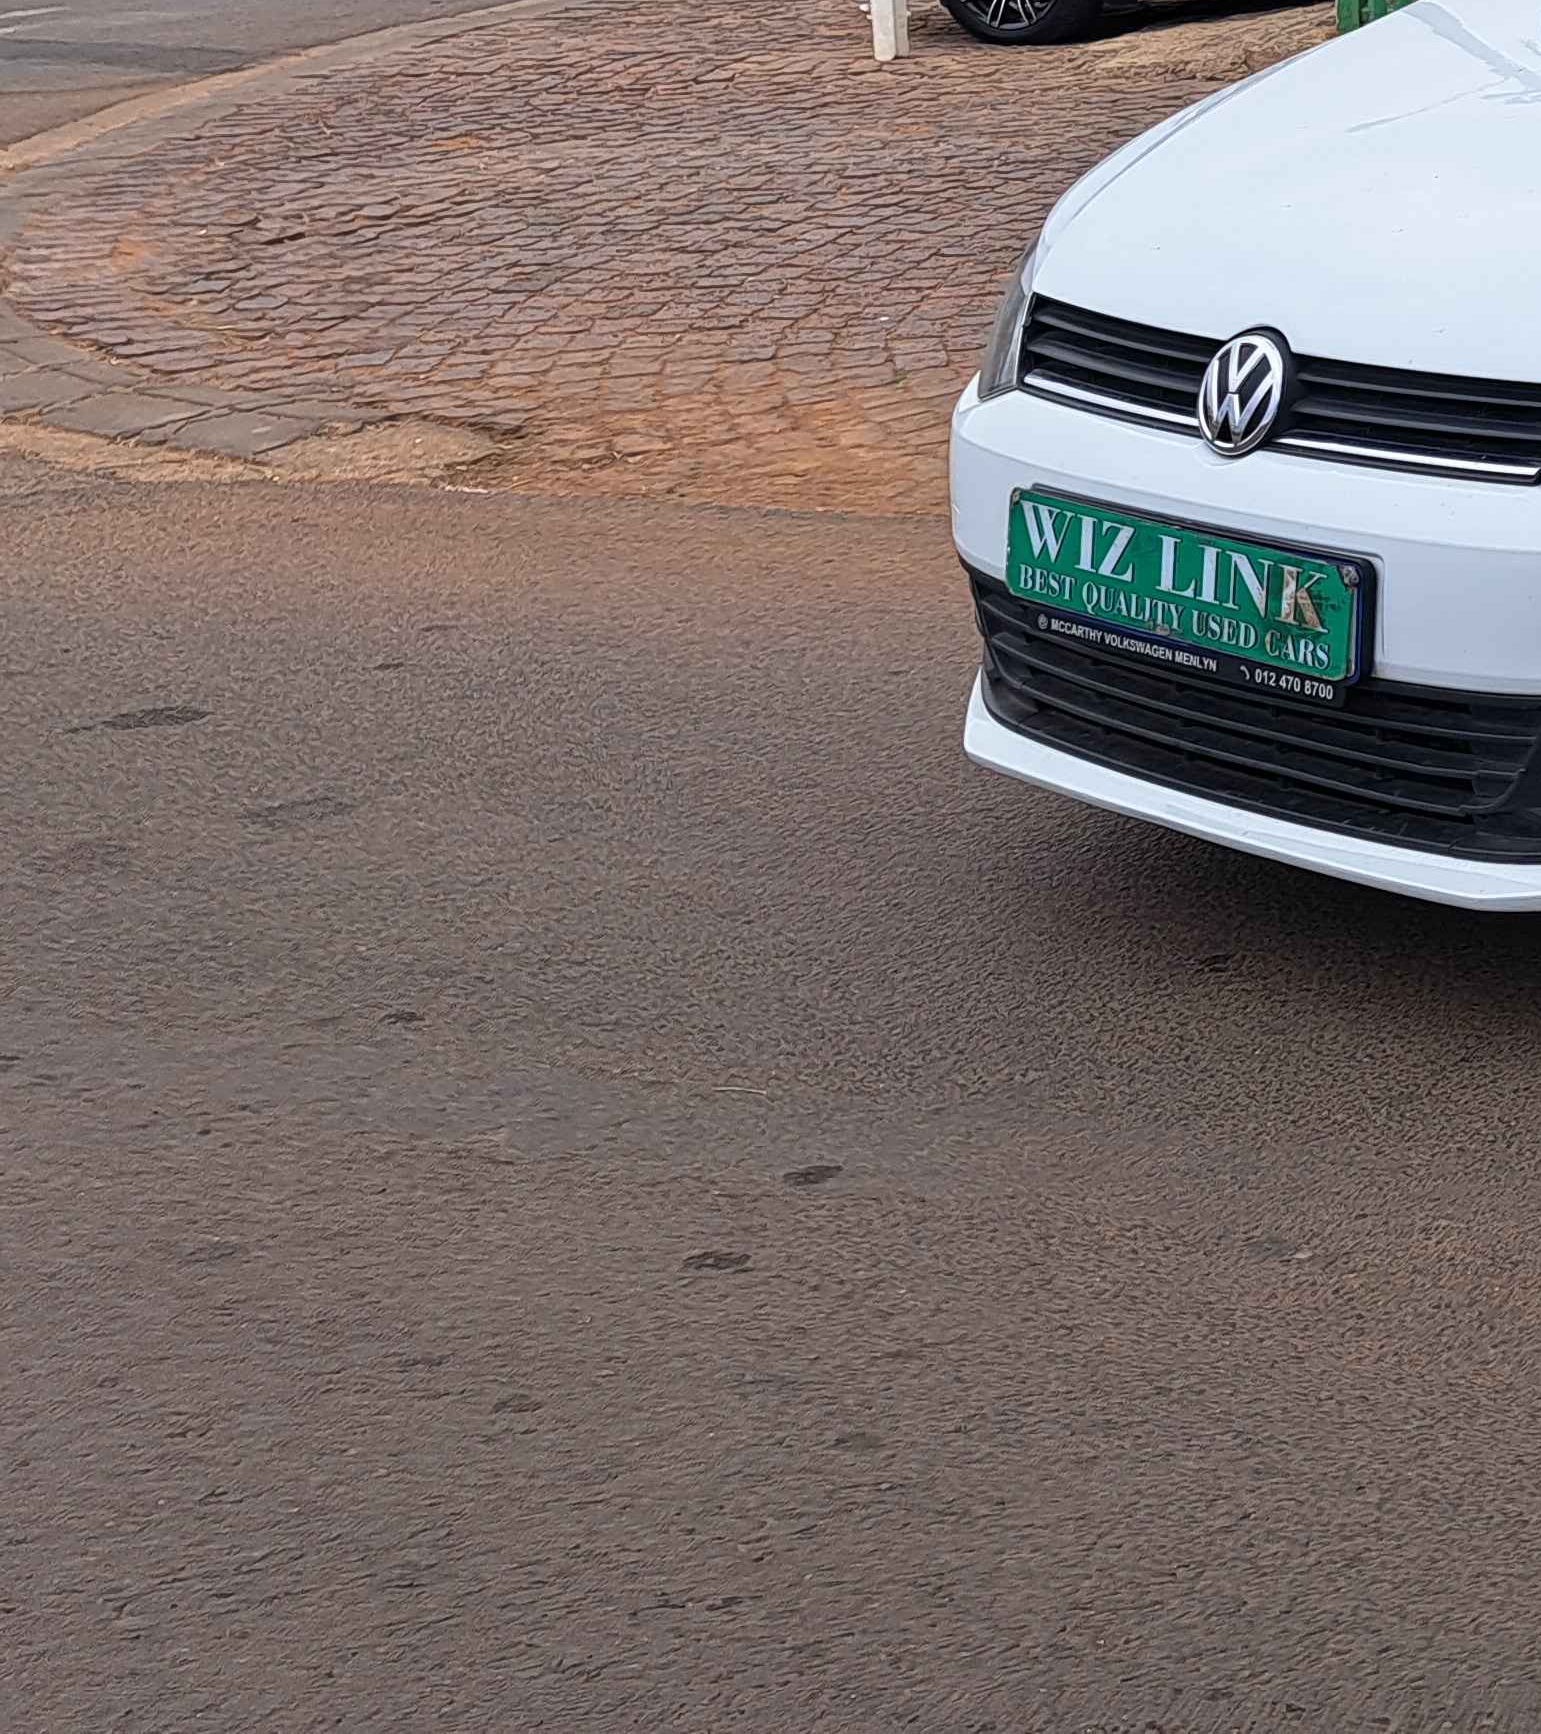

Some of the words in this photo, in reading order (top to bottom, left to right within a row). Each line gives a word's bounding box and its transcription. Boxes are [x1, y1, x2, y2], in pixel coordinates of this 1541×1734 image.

[1020, 499, 1137, 584] WIZ
[1155, 533, 1330, 636] LINK
[1018, 563, 1078, 602] BEST
[1081, 581, 1186, 632] QUALITY
[1191, 611, 1259, 650] USED
[1264, 628, 1331, 670] CARS
[1050, 617, 1103, 643] MCCARTHY
[1104, 631, 1173, 661] VOLKSWAGEN
[1174, 650, 1218, 673] MENLYN
[1254, 668, 1277, 687] 012
[1279, 673, 1301, 693] 470
[1303, 678, 1334, 701] 8700
